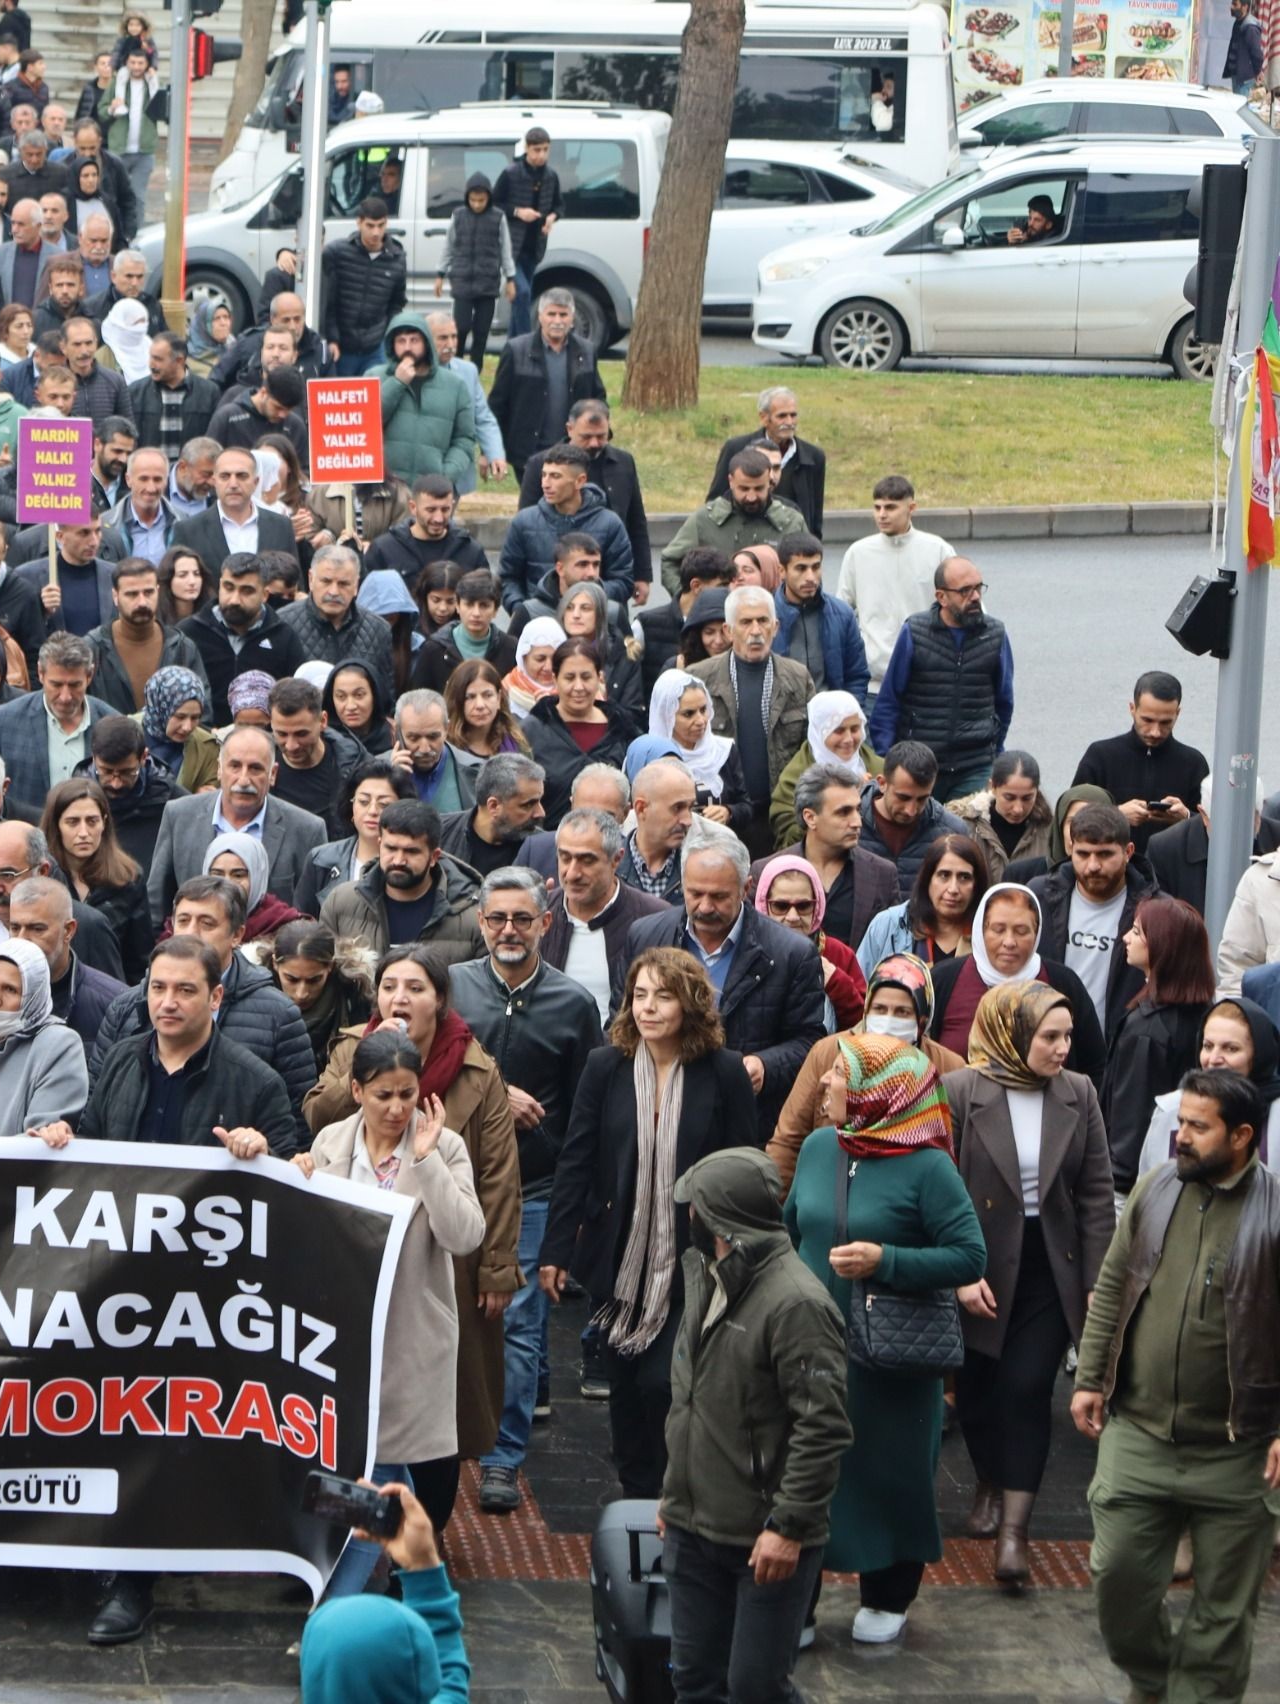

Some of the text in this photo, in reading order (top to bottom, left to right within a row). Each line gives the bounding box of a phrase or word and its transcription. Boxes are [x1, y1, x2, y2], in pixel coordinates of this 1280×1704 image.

[834, 37, 892, 50] LUX 2012 XL
[317, 387, 369, 405] HALFETİ
[324, 412, 363, 427] HALKI
[30, 427, 79, 443] MARDİN
[322, 433, 367, 448] YALNIZ
[35, 450, 74, 465] HALKI
[317, 452, 374, 470] DEĞİLDİR
[32, 472, 77, 487] YALNIZ
[25, 492, 83, 510] DEĞİLDİR
[13, 1185, 268, 1267] KARŞI
